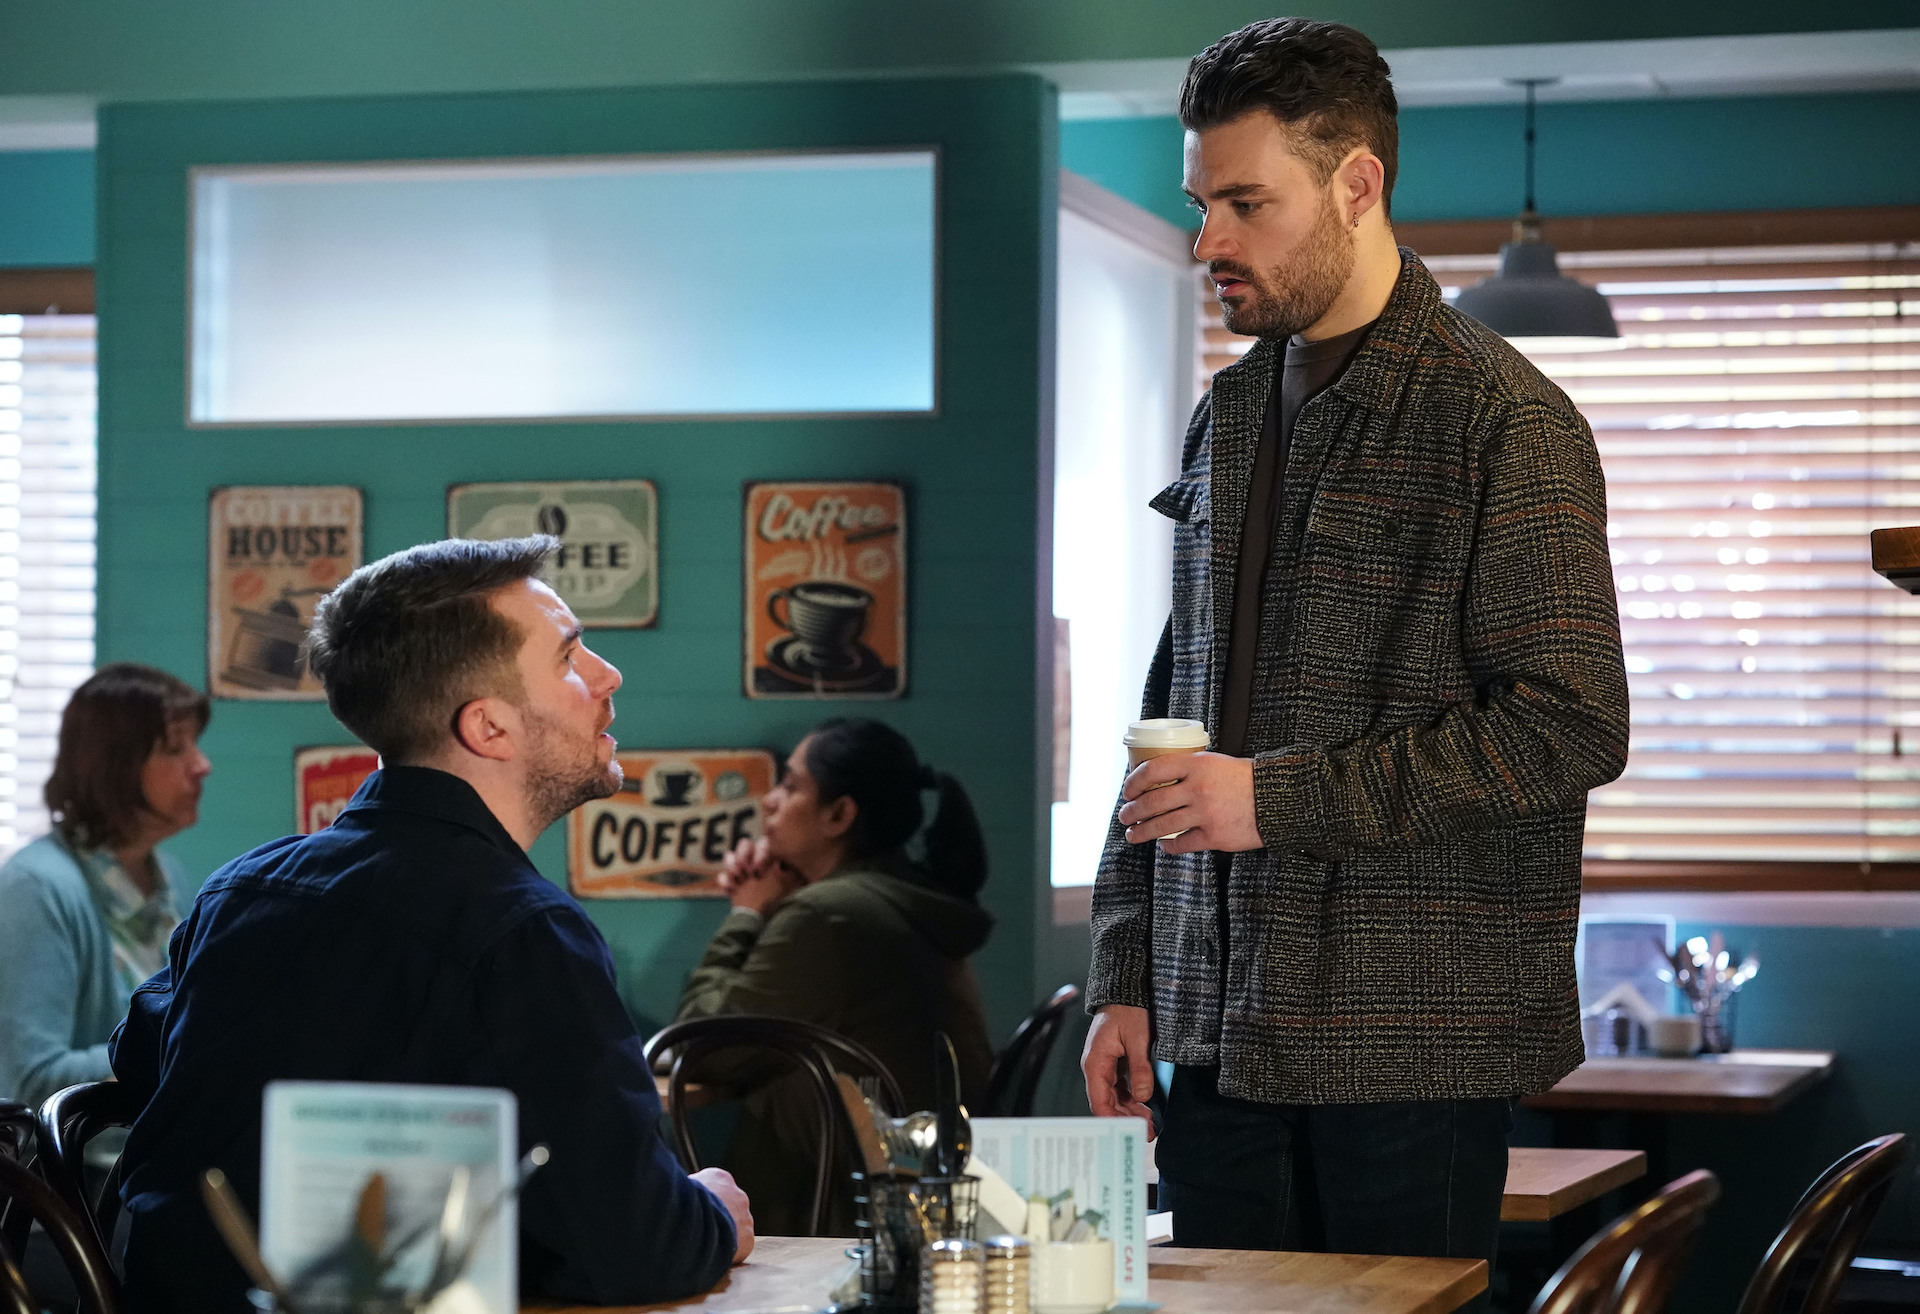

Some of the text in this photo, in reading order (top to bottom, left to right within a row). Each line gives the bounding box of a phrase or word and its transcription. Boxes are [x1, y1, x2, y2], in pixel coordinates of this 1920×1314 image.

[759, 493, 888, 542] Coffee
[228, 525, 348, 558] HOUSE
[556, 541, 631, 569] FEE
[1123, 1135, 1134, 1284] BRIDGE STREET CAFE
